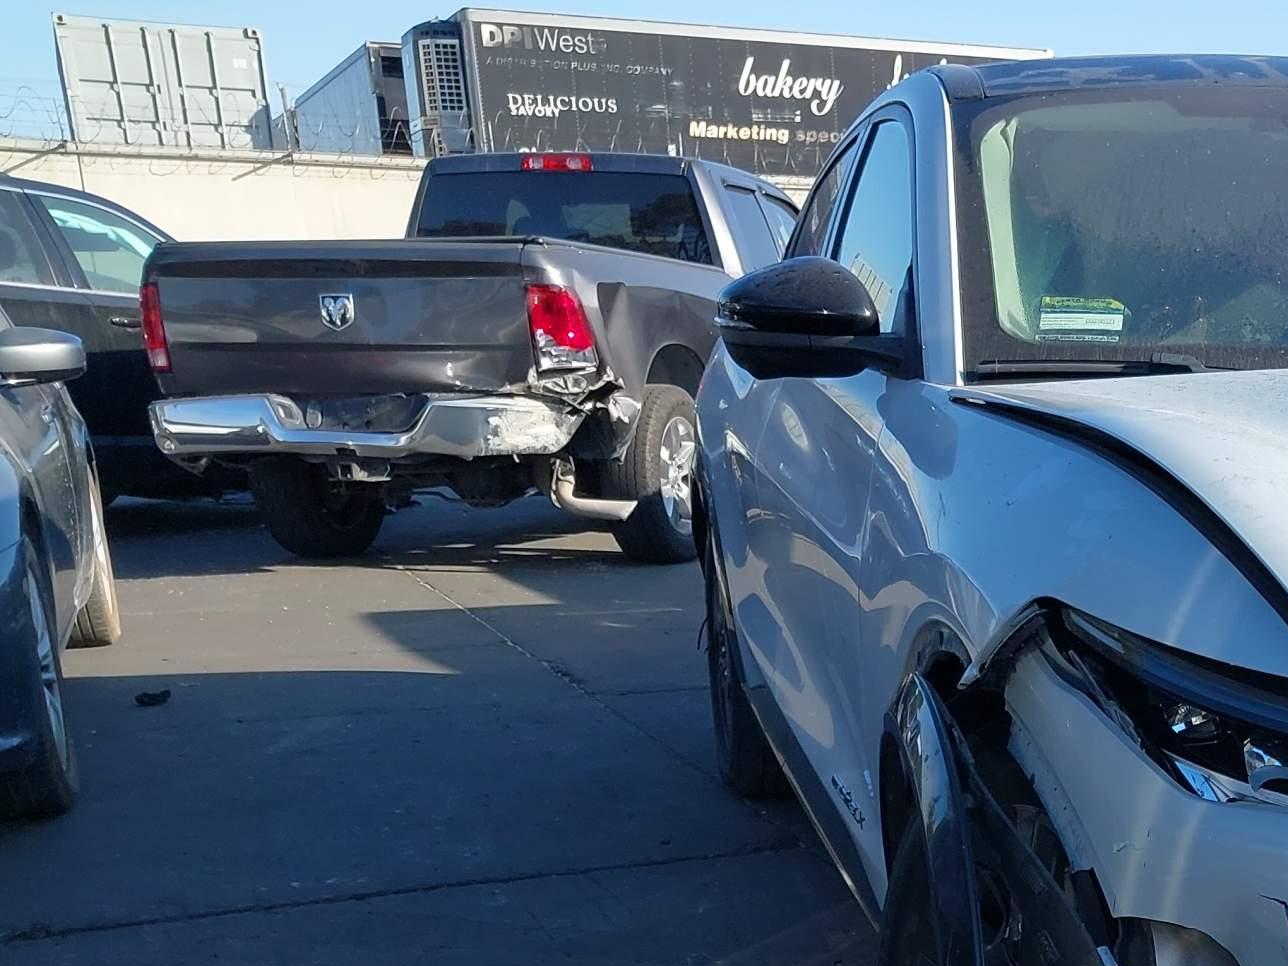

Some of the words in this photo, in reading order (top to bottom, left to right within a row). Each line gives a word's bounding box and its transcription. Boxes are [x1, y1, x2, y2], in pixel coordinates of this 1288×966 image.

[534, 27, 597, 54] West
[571, 61, 597, 72] PLUS
[739, 56, 844, 116] bakery
[507, 93, 617, 114] DELICIOUS
[689, 120, 790, 144] Marketing
